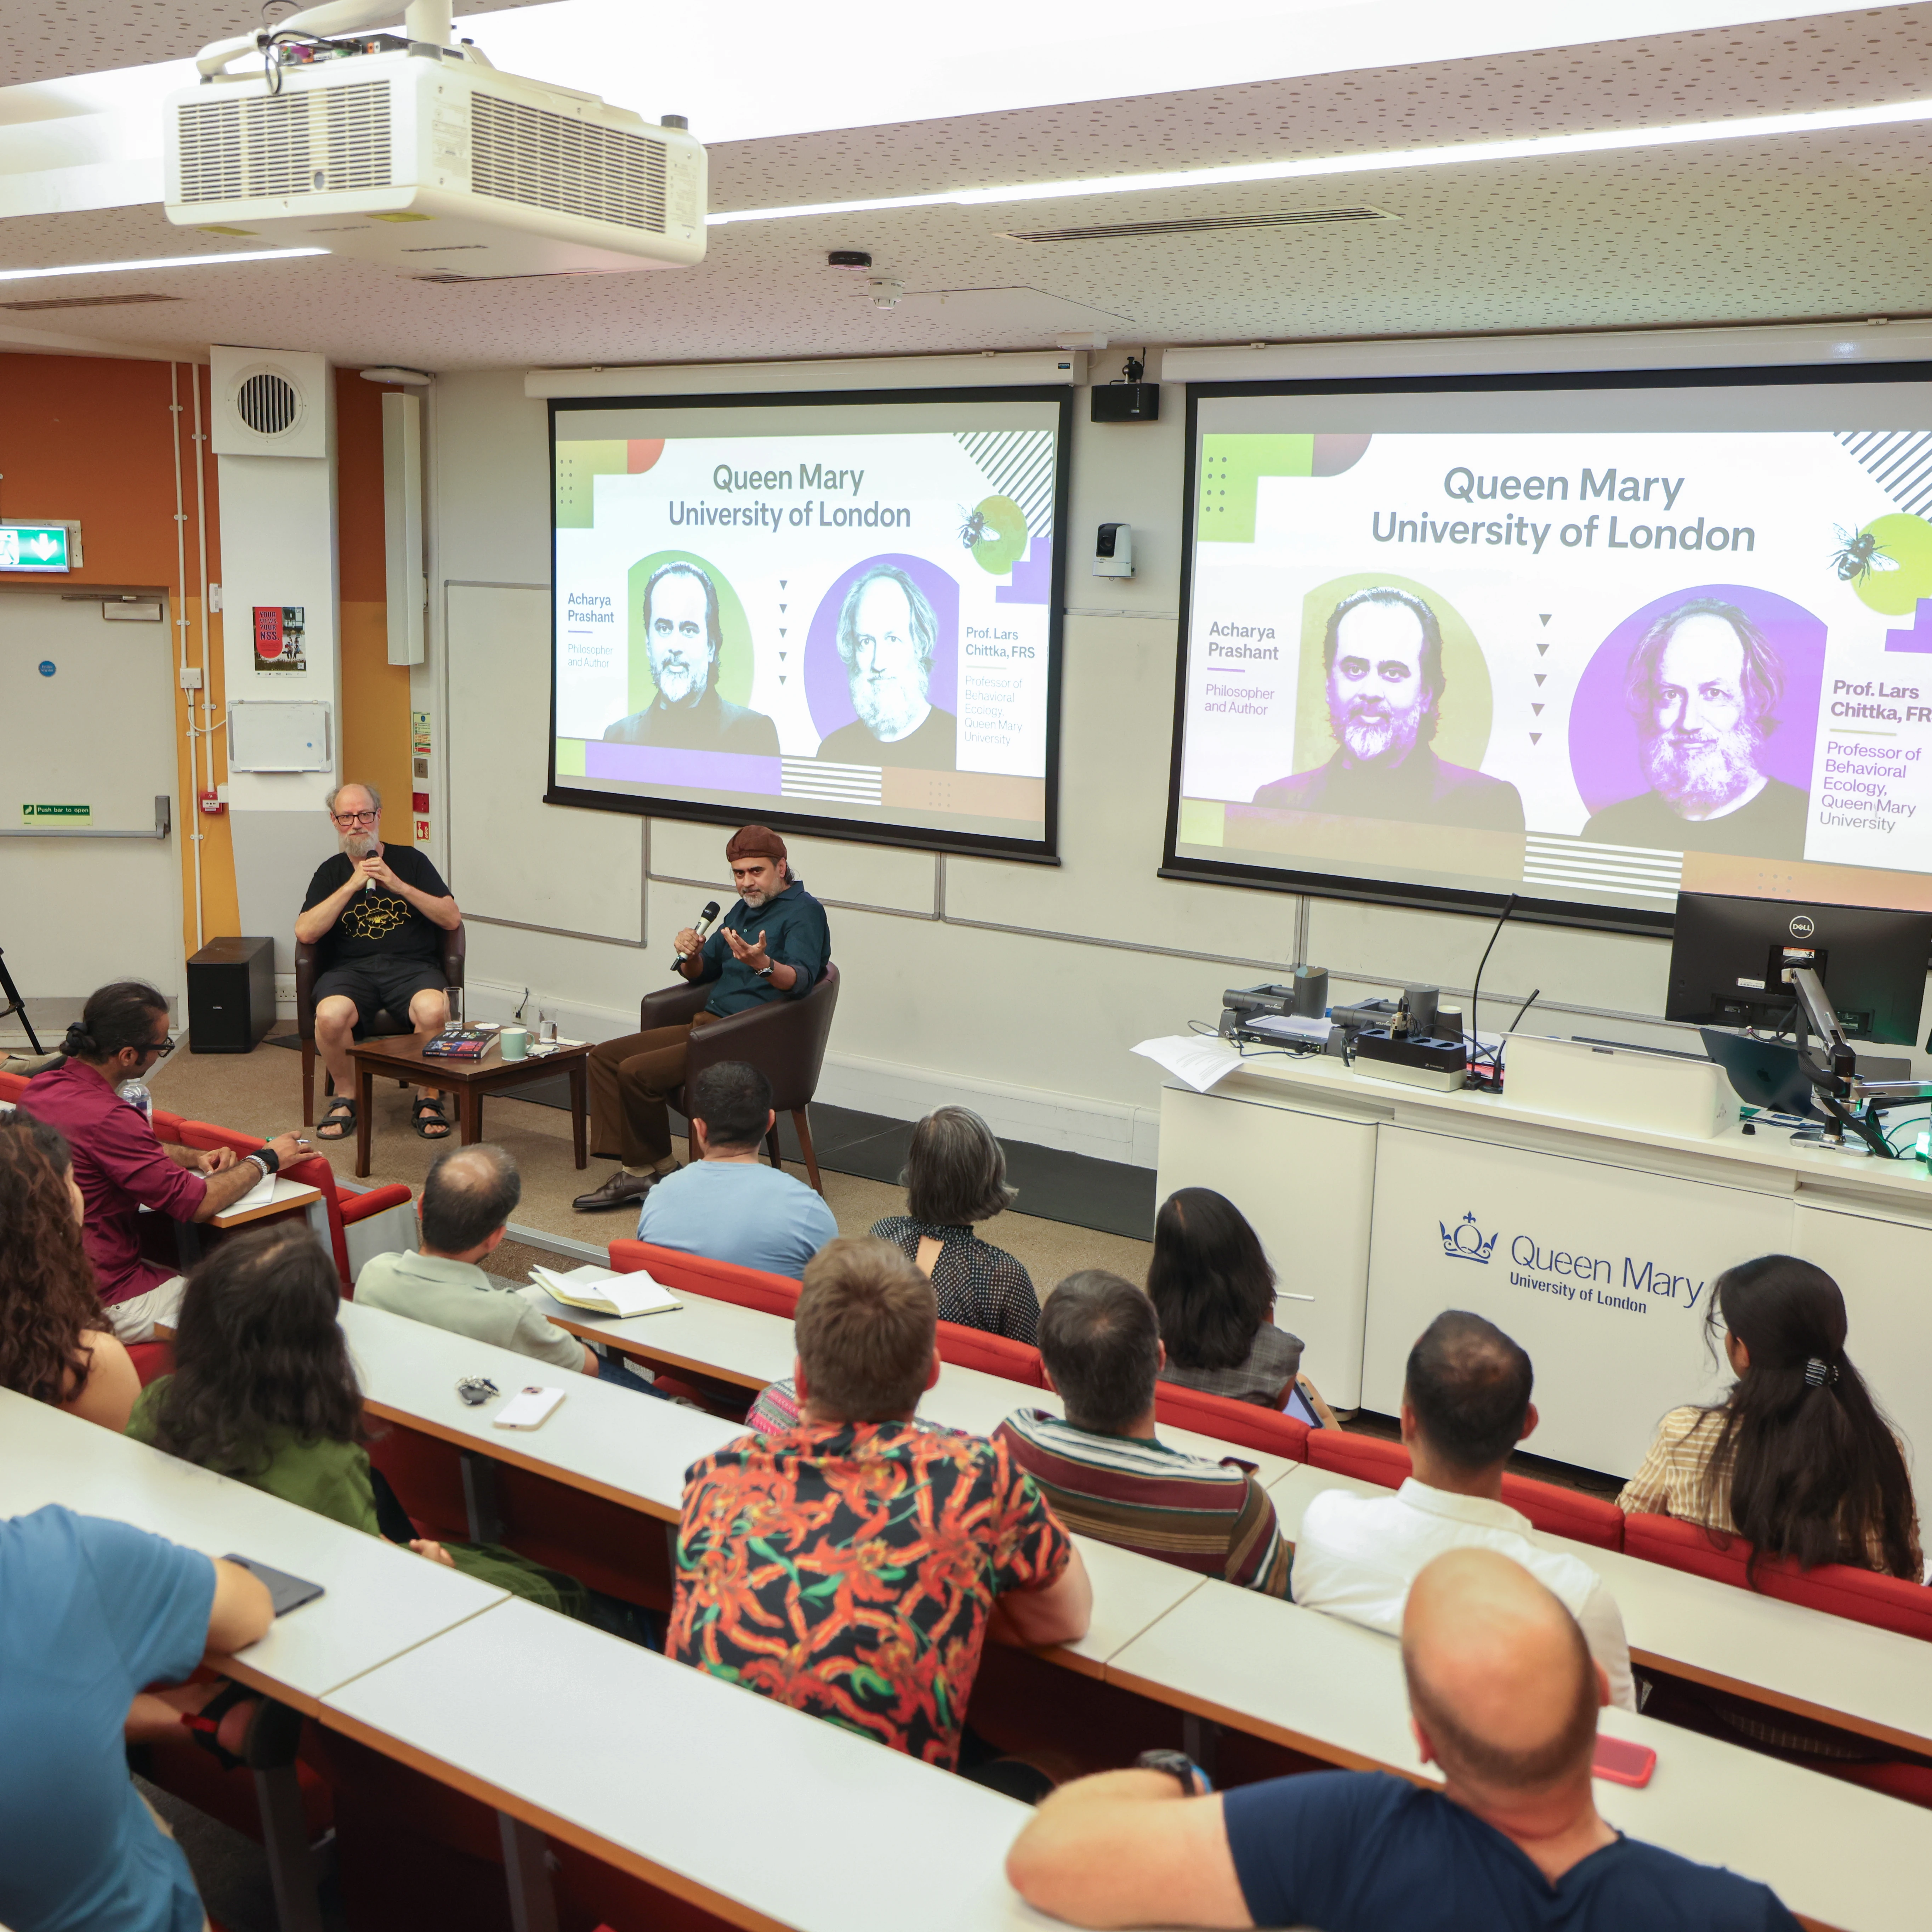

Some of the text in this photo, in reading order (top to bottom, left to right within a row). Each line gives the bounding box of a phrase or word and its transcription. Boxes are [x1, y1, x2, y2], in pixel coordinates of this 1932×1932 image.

[714, 464, 864, 496] Queen Mary
[1444, 467, 1684, 510] Queen Mary
[670, 500, 910, 533] University of London
[1373, 511, 1755, 554] University of London
[568, 593, 611, 608] Acharya
[568, 610, 614, 623] Prashant
[260, 631, 280, 641] NSS.
[966, 627, 1018, 640] Prof. Lars
[1209, 621, 1275, 642] Acharya
[568, 644, 613, 655] Philosopher
[966, 644, 1035, 659] Chittka, FRS
[1209, 642, 1279, 660] Prashant
[568, 658, 609, 667] and Author
[966, 676, 1022, 688] Professor of
[1833, 680, 1919, 699] Prof. Lars
[966, 689, 1014, 702] Behavioral
[1206, 684, 1275, 700] Philosopher
[965, 704, 1004, 718] Ecology,
[1205, 701, 1268, 715] and Author
[1831, 701, 1932, 723] Chittka, FR
[965, 718, 1022, 733] Queen Mary
[965, 732, 1011, 746] University
[1827, 741, 1922, 761] Professor of
[1825, 759, 1906, 778] Behavioral
[1824, 777, 1887, 797] Ecology,
[1822, 794, 1916, 818] Queen Mary
[1820, 812, 1896, 834] University
[1512, 1235, 1704, 1309] Queen Mary
[1510, 1272, 1647, 1314] University of London
